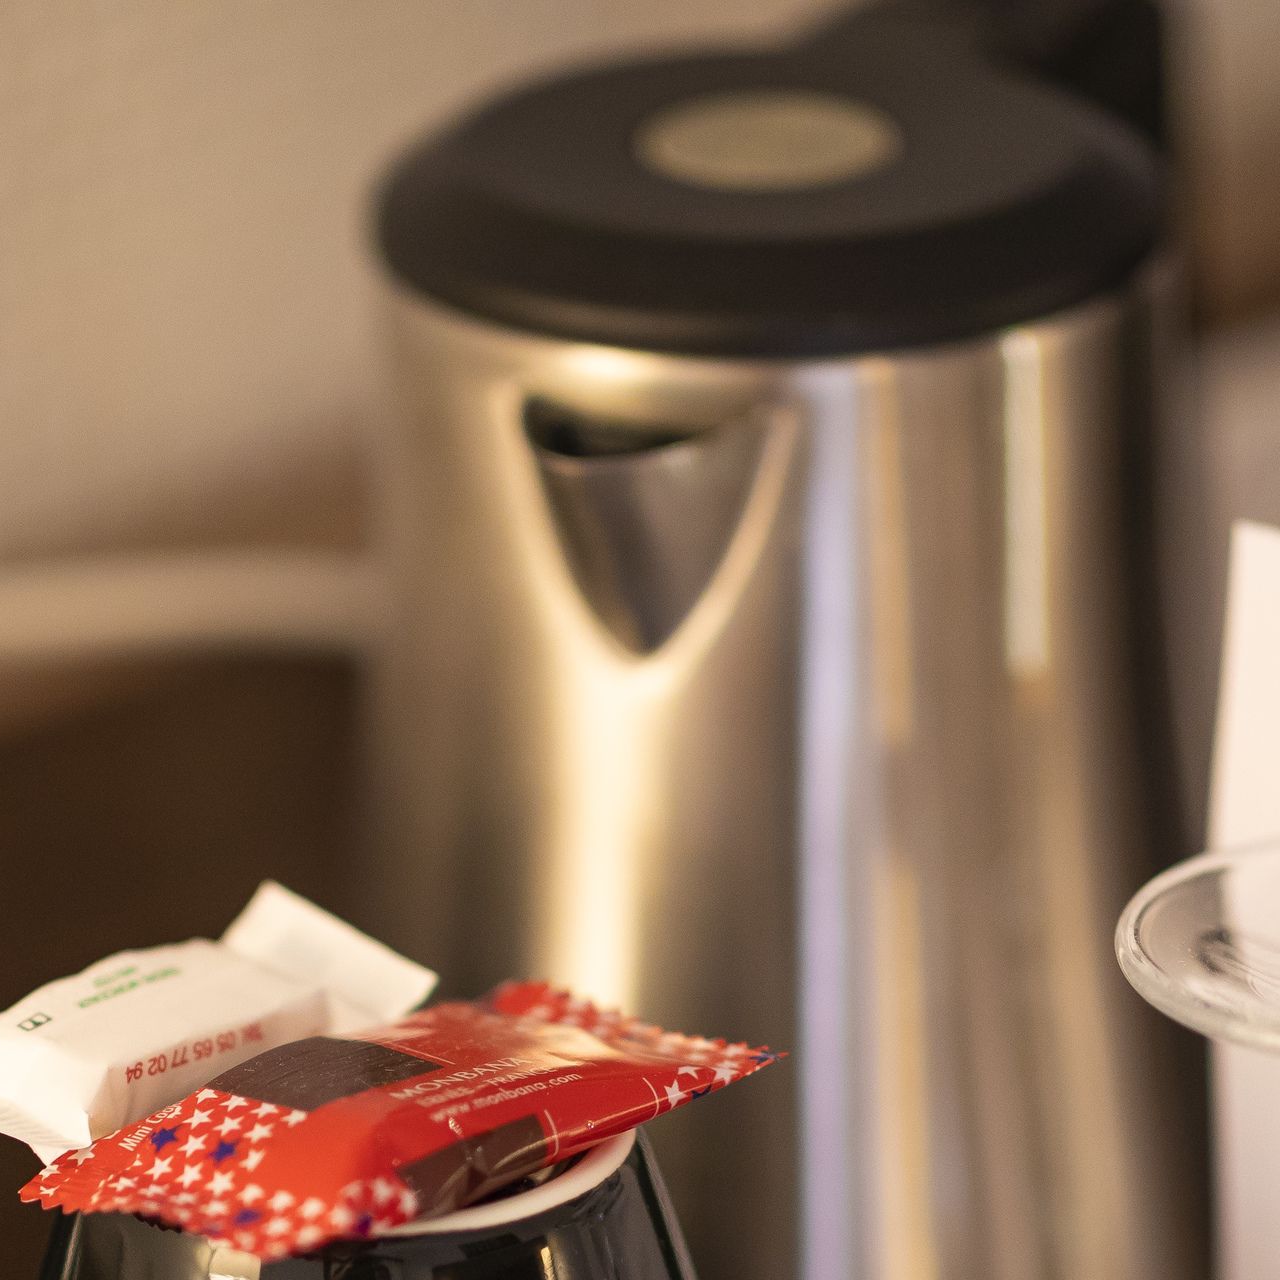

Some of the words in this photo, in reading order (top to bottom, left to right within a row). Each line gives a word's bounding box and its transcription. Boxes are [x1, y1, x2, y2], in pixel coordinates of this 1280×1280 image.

[148, 1054, 167, 1076] 02
[171, 1045, 189, 1068] 77
[125, 1061, 144, 1084] 94
[389, 1056, 528, 1099] MONBANA
[118, 1121, 153, 1152] Mini
[145, 1102, 183, 1125] Coo
